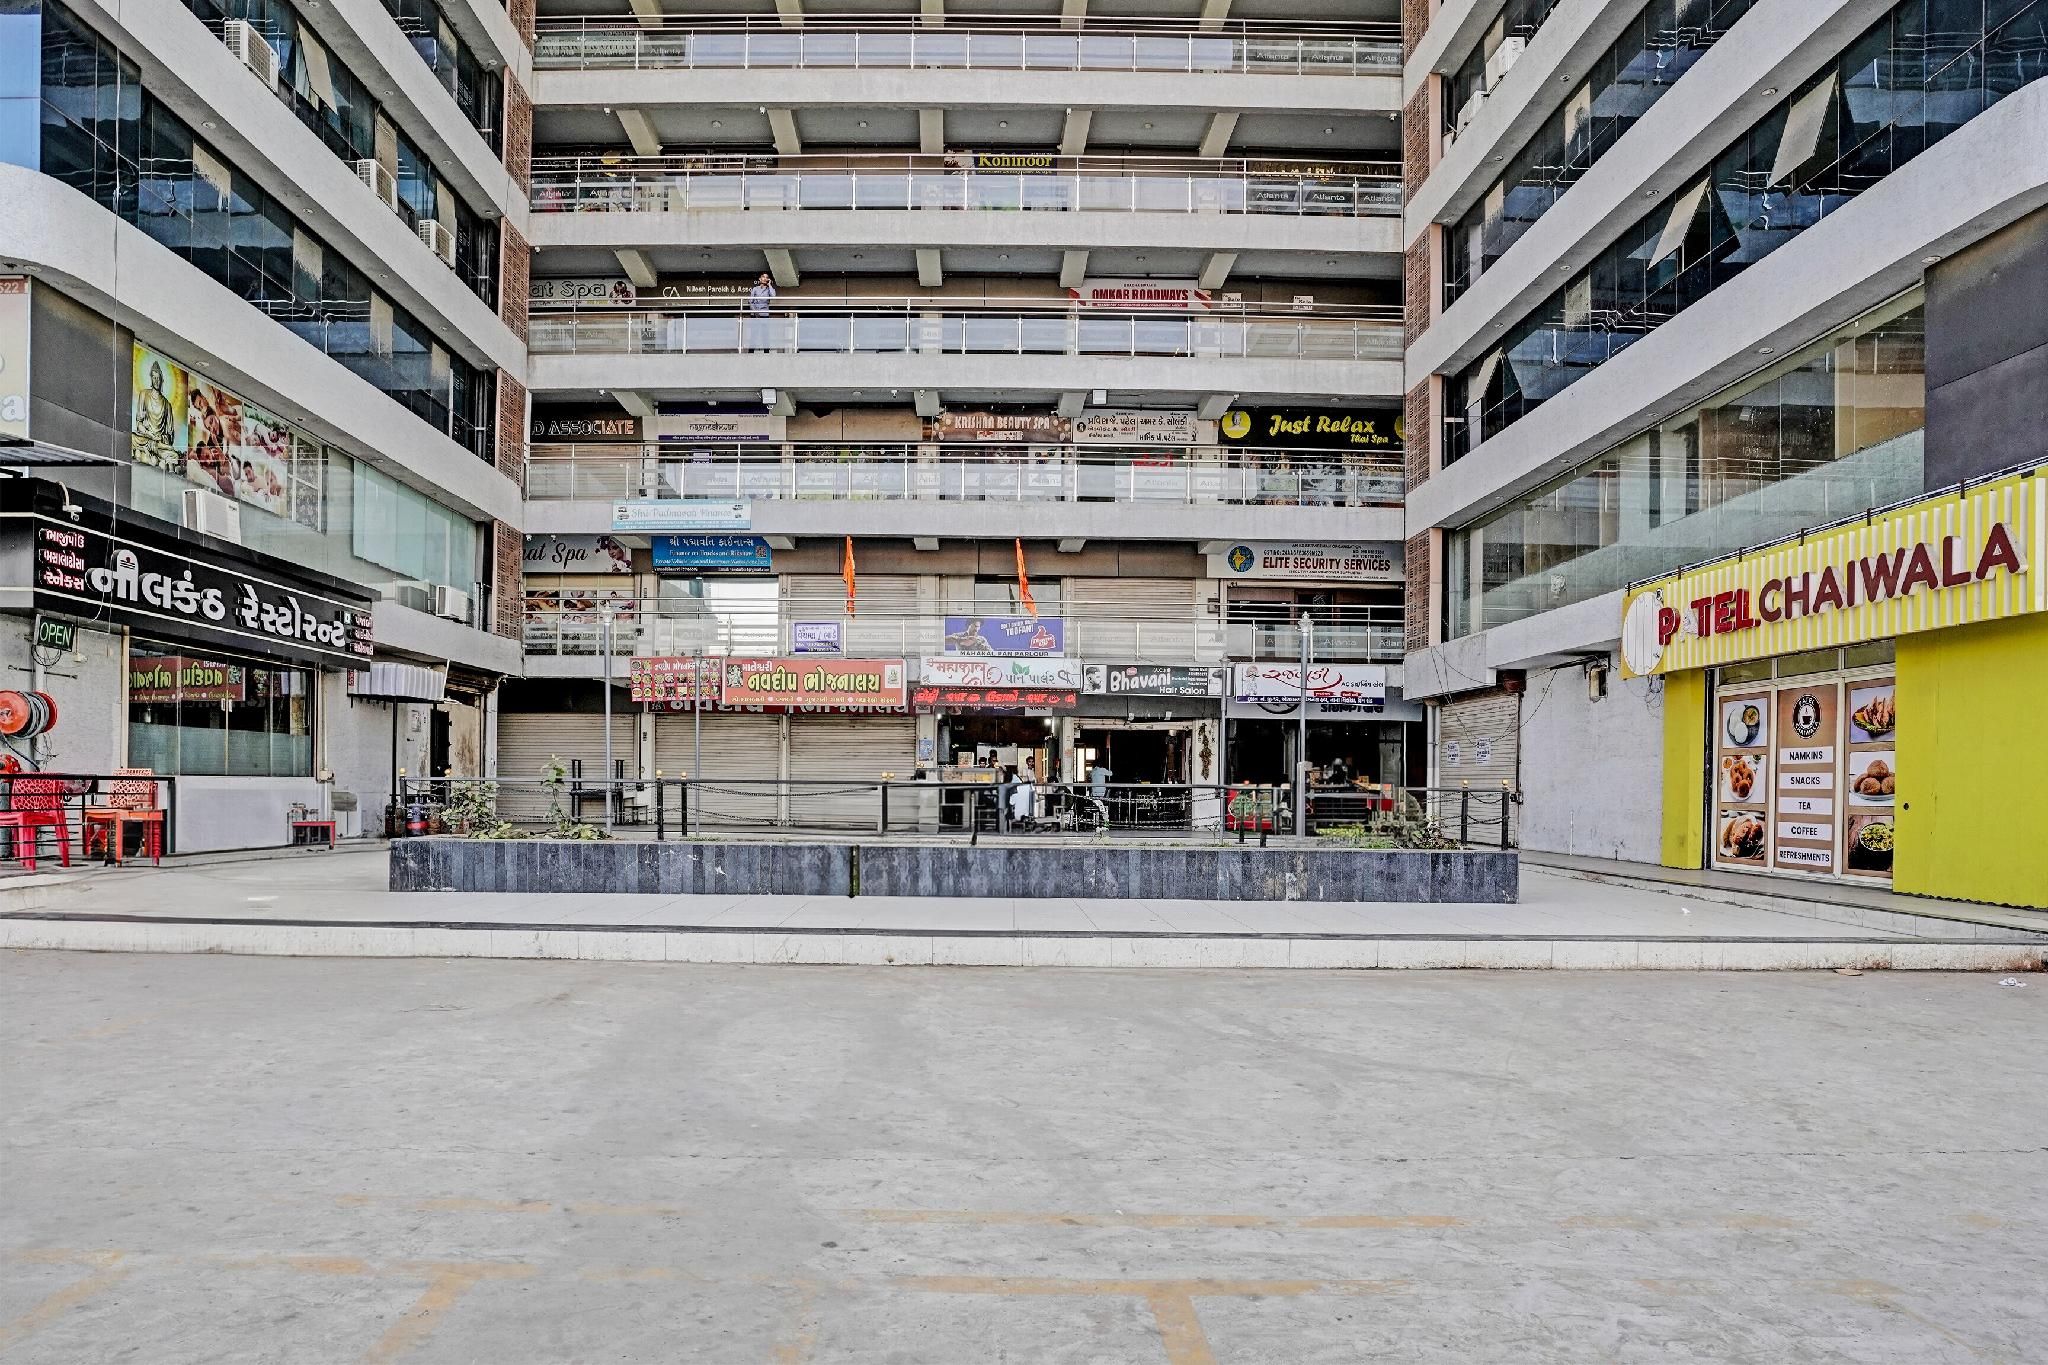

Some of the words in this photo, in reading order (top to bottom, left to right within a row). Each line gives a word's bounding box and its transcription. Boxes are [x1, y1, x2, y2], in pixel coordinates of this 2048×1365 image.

[1257, 52, 1289, 60] Atlanta
[1311, 53, 1344, 61] Atlanta
[1364, 54, 1398, 62] Atlanta
[979, 152, 1053, 167] Kohinoor
[1256, 191, 1289, 200] Atlanta
[1312, 192, 1345, 201] Atlanta
[560, 280, 606, 299] Spa
[1092, 289, 1129, 300] OMKAR
[1131, 289, 1189, 301] ROADWAYS
[955, 415, 995, 429] KRISHNA
[997, 416, 1032, 430] BEAUTY
[1033, 416, 1050, 430] SPA
[1120, 415, 1136, 426] પટેલ
[1268, 414, 1312, 437] Just
[1316, 415, 1376, 433] Relax
[547, 420, 634, 436] ASSOCIATE
[1371, 434, 1389, 445] Spa
[669, 535, 680, 547] શ્રી
[551, 541, 589, 570] Spa
[1262, 557, 1290, 569] ELITE
[1293, 557, 1341, 570] SECURITY
[1343, 558, 1391, 572] SERVICES
[1758, 522, 2027, 622] CHAIWALA
[88, 550, 227, 621] નીલકંઠ
[240, 583, 346, 648] રેસ્ટોરન્ટ
[39, 622, 72, 647] OPEN
[747, 665, 798, 692] નવદીપ
[803, 665, 881, 692] ભોજનાલય
[1005, 673, 1024, 684] પાન
[1029, 670, 1056, 685] પાર્લર
[1110, 667, 1171, 692] Bhavani
[1159, 686, 1178, 695] Hair
[1180, 686, 1206, 696] Salon
[1789, 750, 1823, 760] NAMKINS
[1790, 776, 1821, 785] SNACKS
[1798, 801, 1812, 810] TEA
[1790, 825, 1818, 836] COFFEE
[1779, 850, 1830, 862] REFRESHMENTS
